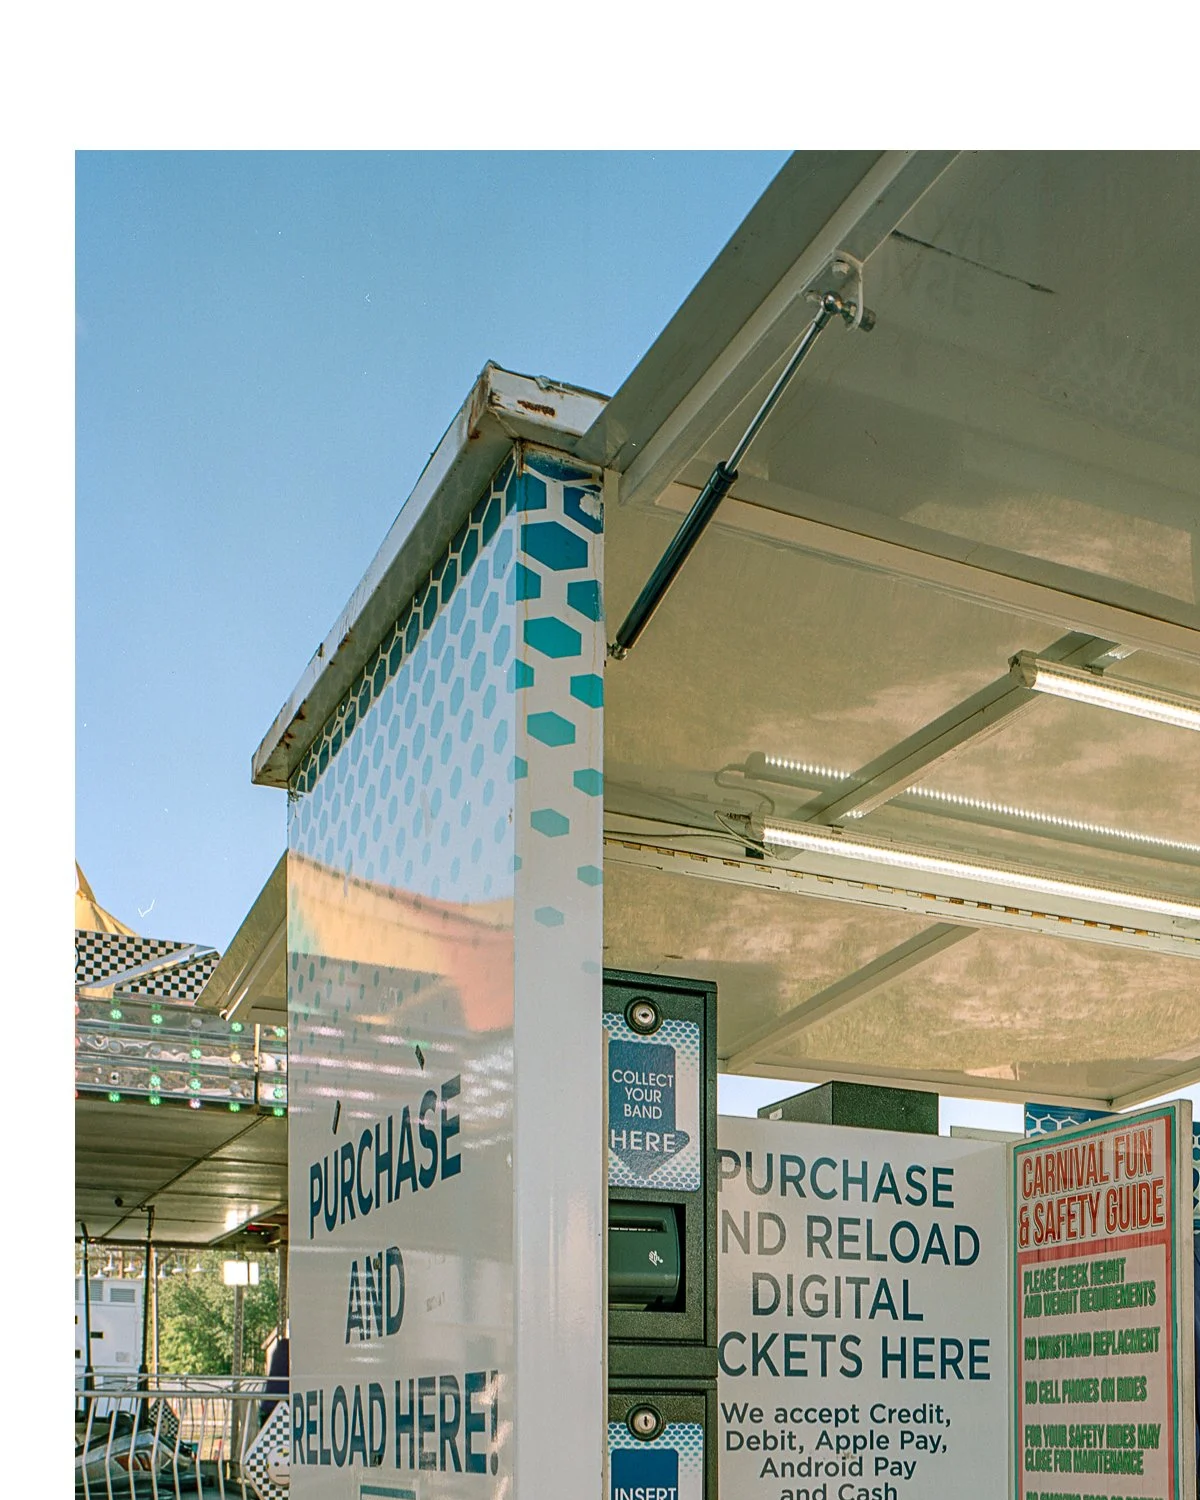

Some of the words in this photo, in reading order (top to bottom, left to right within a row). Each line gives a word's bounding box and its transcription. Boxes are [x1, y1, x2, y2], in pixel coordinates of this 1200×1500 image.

[611, 1069, 674, 1087] COLLECT
[623, 1104, 663, 1120] BAND
[625, 1087, 662, 1104] YOUR
[309, 1073, 463, 1240] PURCHASE
[610, 1129, 677, 1153] HERE
[717, 1149, 955, 1209] PURCHASE
[1023, 1140, 1109, 1198] CARNIVAL
[1114, 1128, 1152, 1180] FUN
[1019, 1205, 1030, 1247] &
[1033, 1191, 1101, 1244] SAFETY
[1106, 1178, 1164, 1232] GUIDE
[721, 1209, 787, 1256] ND
[806, 1215, 981, 1267] RELOAD
[1023, 1267, 1057, 1295] PLEASE
[1058, 1262, 1089, 1290] CHECK
[1090, 1257, 1126, 1286] HEIGHT
[344, 1245, 406, 1345] AND
[751, 1272, 924, 1322] DIGITAL
[1023, 1294, 1042, 1319] AND
[1044, 1290, 1079, 1316] WEIGHT
[1080, 1280, 1156, 1313] REQUIREMENTS
[717, 1331, 863, 1379] CKETS
[881, 1336, 991, 1381] HERE
[1024, 1337, 1037, 1360] NO
[1038, 1332, 1092, 1360] WRISTBAND
[1025, 1380, 1038, 1405] NO
[1039, 1379, 1061, 1404] CELL
[1062, 1378, 1099, 1404] PHONES
[1101, 1377, 1115, 1403] ON
[1116, 1375, 1147, 1402] RIDES
[291, 1381, 387, 1468] RELOAD
[395, 1369, 500, 1477] HERE!
[720, 1403, 764, 1424] We
[774, 1405, 859, 1428] accept
[869, 1403, 951, 1427] Credit,
[725, 1430, 805, 1454] Debit,
[815, 1430, 890, 1455] Apple
[900, 1430, 948, 1454] Pay,
[1025, 1424, 1042, 1448] FOR
[1043, 1424, 1068, 1448] YOUR
[1068, 1423, 1105, 1449] SAFETY
[1106, 1424, 1136, 1449] RIDES
[1137, 1423, 1161, 1449] MAY
[759, 1456, 864, 1478] Android
[874, 1457, 917, 1480] Pay
[1025, 1448, 1053, 1472] CLOSE
[1054, 1449, 1072, 1473] FOR
[1073, 1449, 1144, 1475] MAINTENANCE
